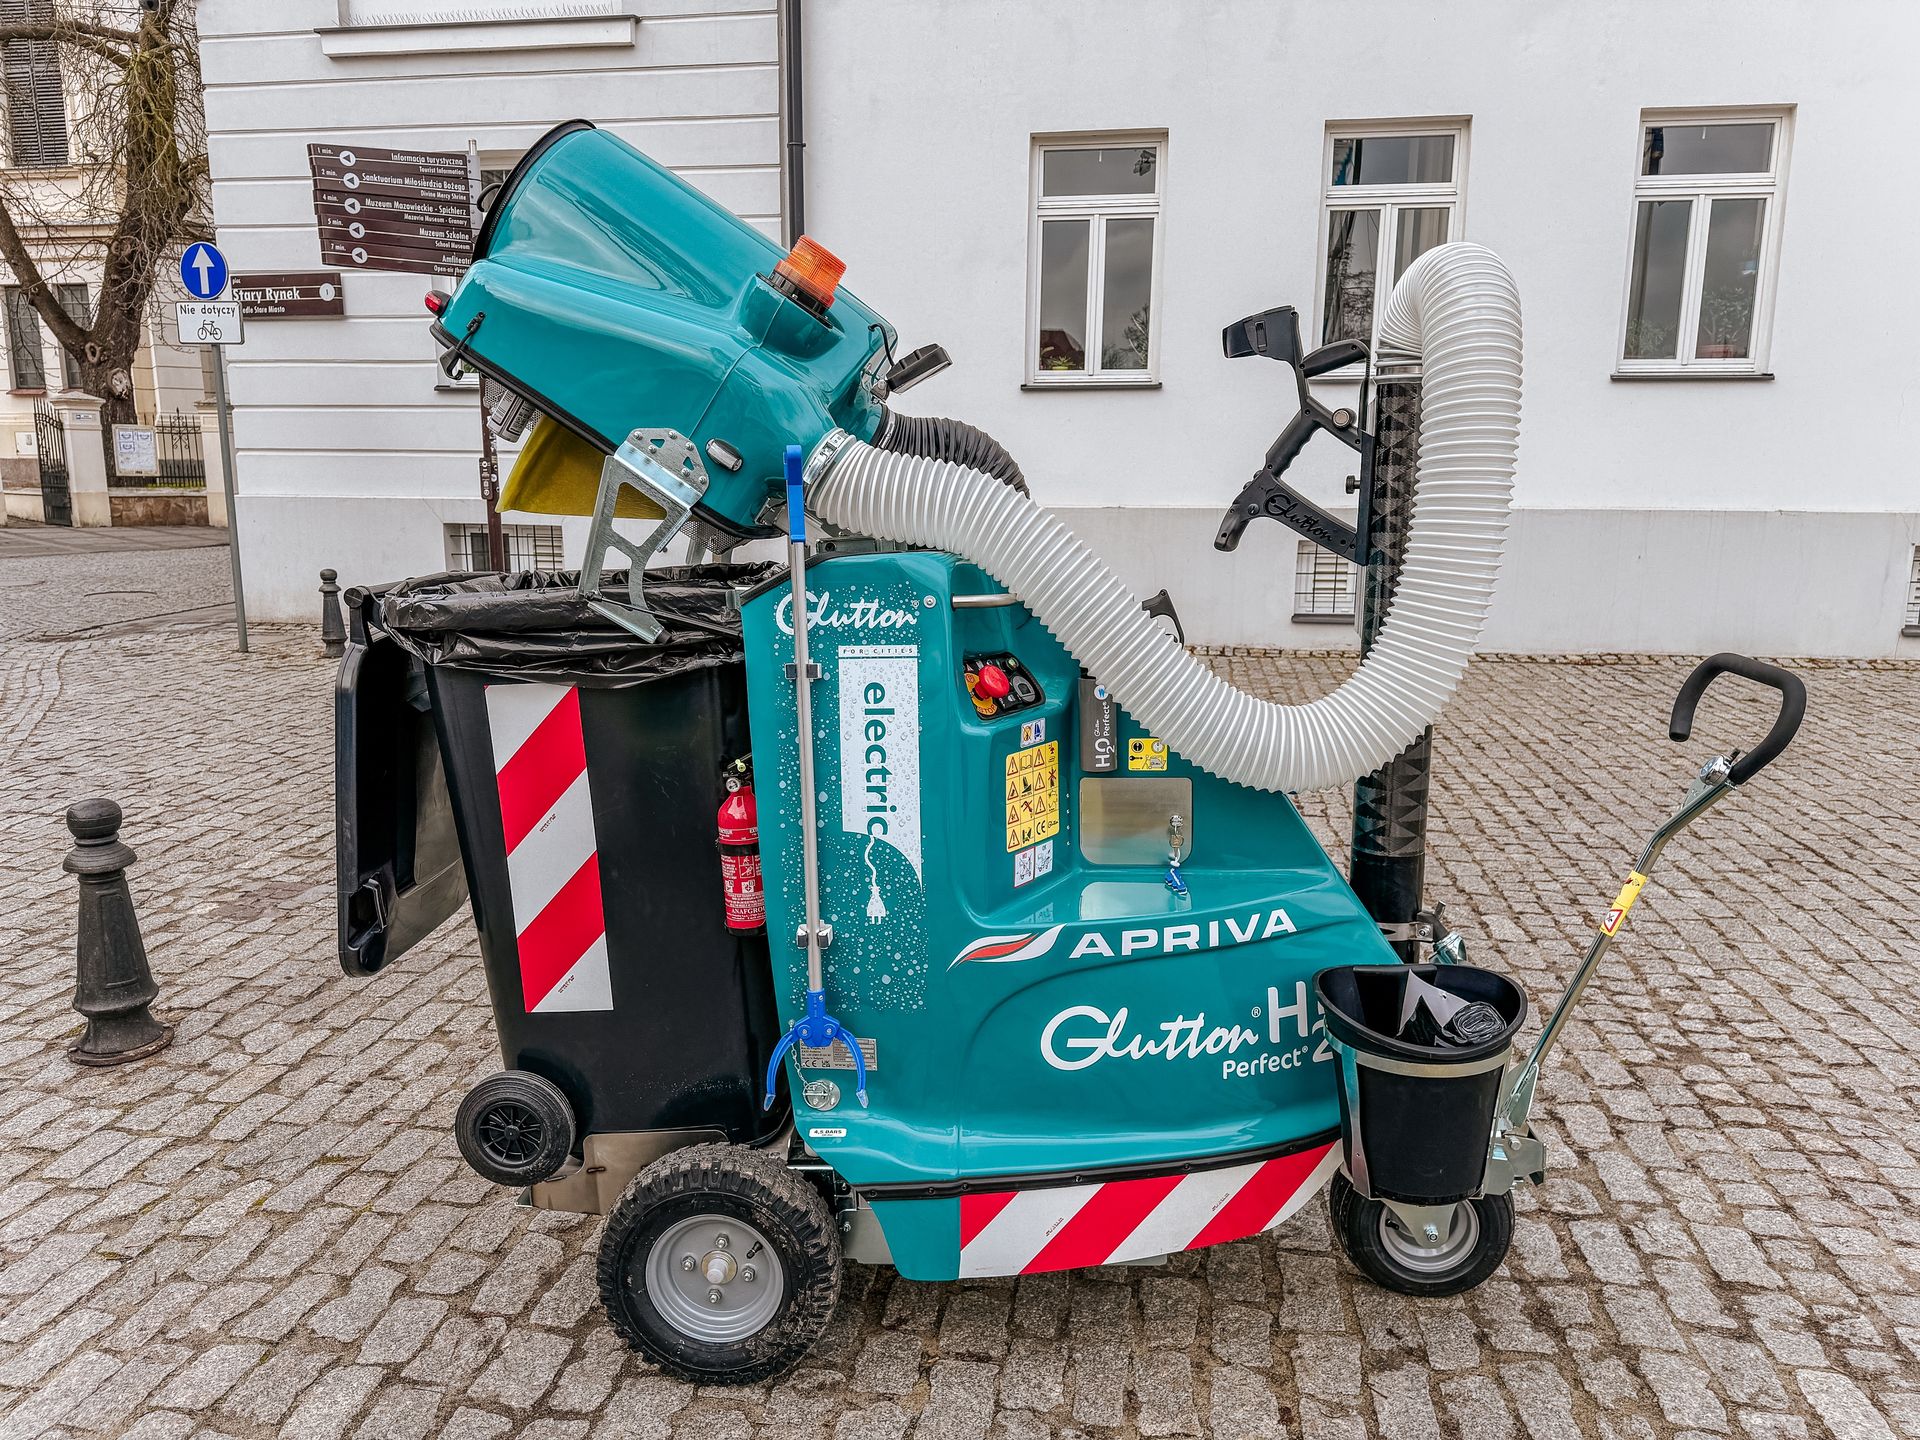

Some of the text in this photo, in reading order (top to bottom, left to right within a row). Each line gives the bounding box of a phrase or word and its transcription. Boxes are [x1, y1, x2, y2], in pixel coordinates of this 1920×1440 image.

[391, 152, 463, 166] Informacja turystyczna
[436, 167, 465, 175] Information
[361, 173, 403, 185] Sanktuarium
[443, 180, 465, 191] Bożego
[436, 191, 450, 200] Mercy
[451, 192, 466, 201] Shrine
[365, 198, 393, 208] Muzeum
[393, 200, 433, 212] Mazowieckie
[439, 205, 466, 215] Spichlerz
[327, 217, 331, 225] 5
[404, 213, 424, 221] Mazovia
[424, 215, 444, 223] Museum
[448, 217, 467, 226] Granary
[419, 227, 469, 240] Muzeum Szkolne
[435, 240, 470, 250] School Museum
[433, 264, 454, 273] Open-air
[232, 288, 262, 304] Stary
[265, 286, 301, 303] Rynek
[180, 304, 236, 318] Nie dotyczy
[242, 305, 285, 314] edle Stare Miasto
[1264, 494, 1332, 542] Glutton
[864, 682, 897, 836] electric
[731, 905, 766, 915] ANAFGRO
[1068, 908, 1298, 959] APRIVA
